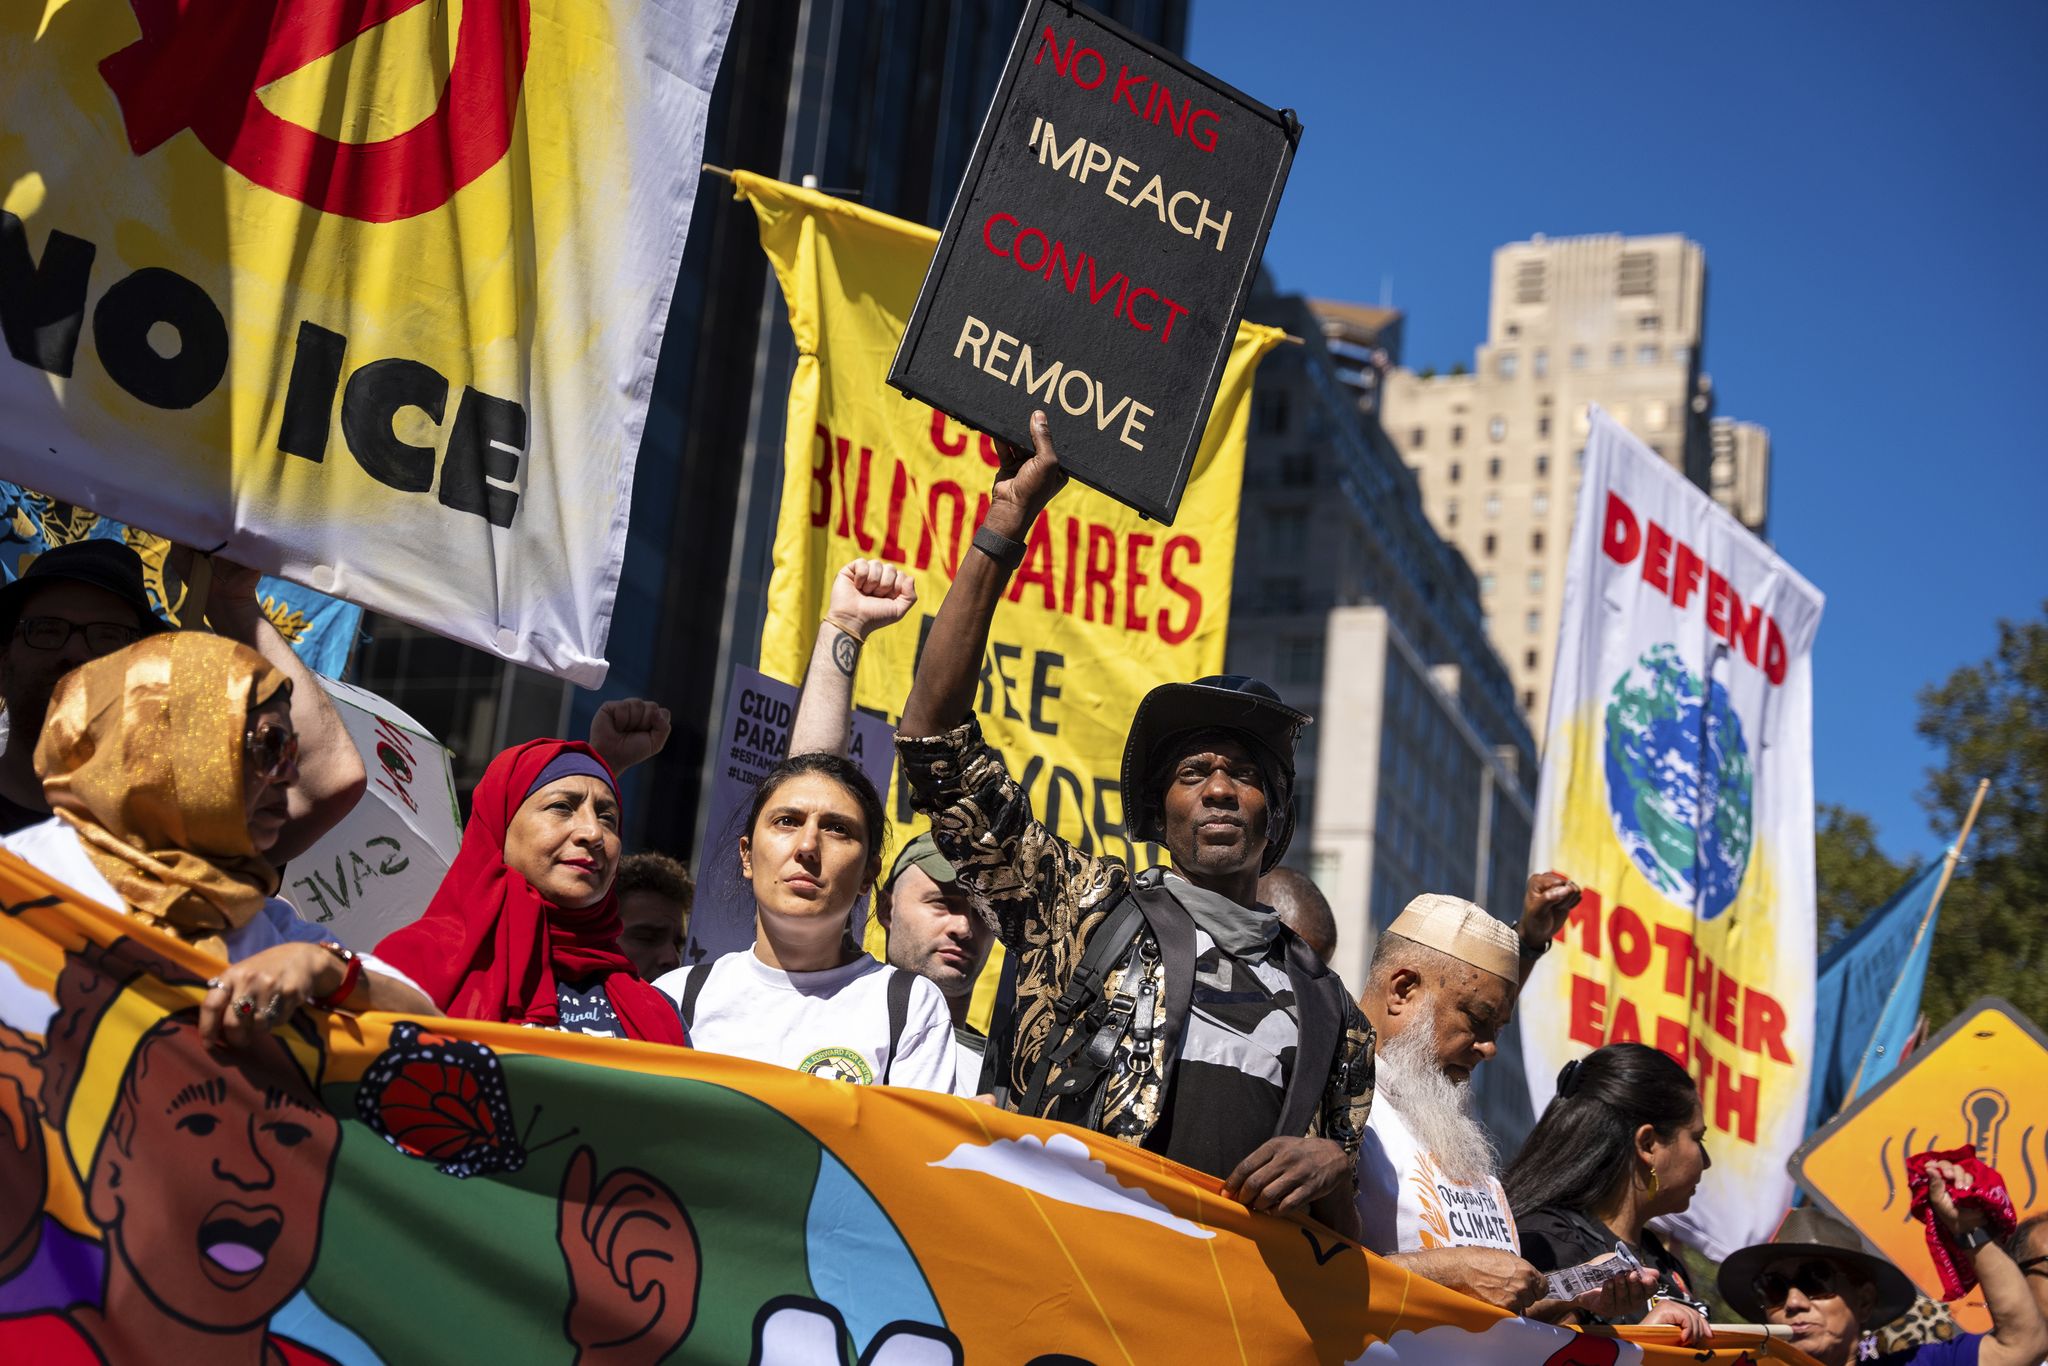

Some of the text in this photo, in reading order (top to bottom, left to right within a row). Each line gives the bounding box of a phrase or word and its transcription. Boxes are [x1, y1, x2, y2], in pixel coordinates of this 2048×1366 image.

[1034, 25, 1221, 152] NO KING
[1029, 117, 1232, 251] IMPEACH
[983, 212, 1189, 344] CONVICT
[0, 209, 526, 529] NO ICE
[953, 315, 1155, 451] REMOVE
[1602, 488, 1788, 687] DEFEND
[590, 995, 609, 1009] ST.
[1551, 870, 1794, 1066] MOTHER
[1449, 1210, 1511, 1244] CLIMATE
